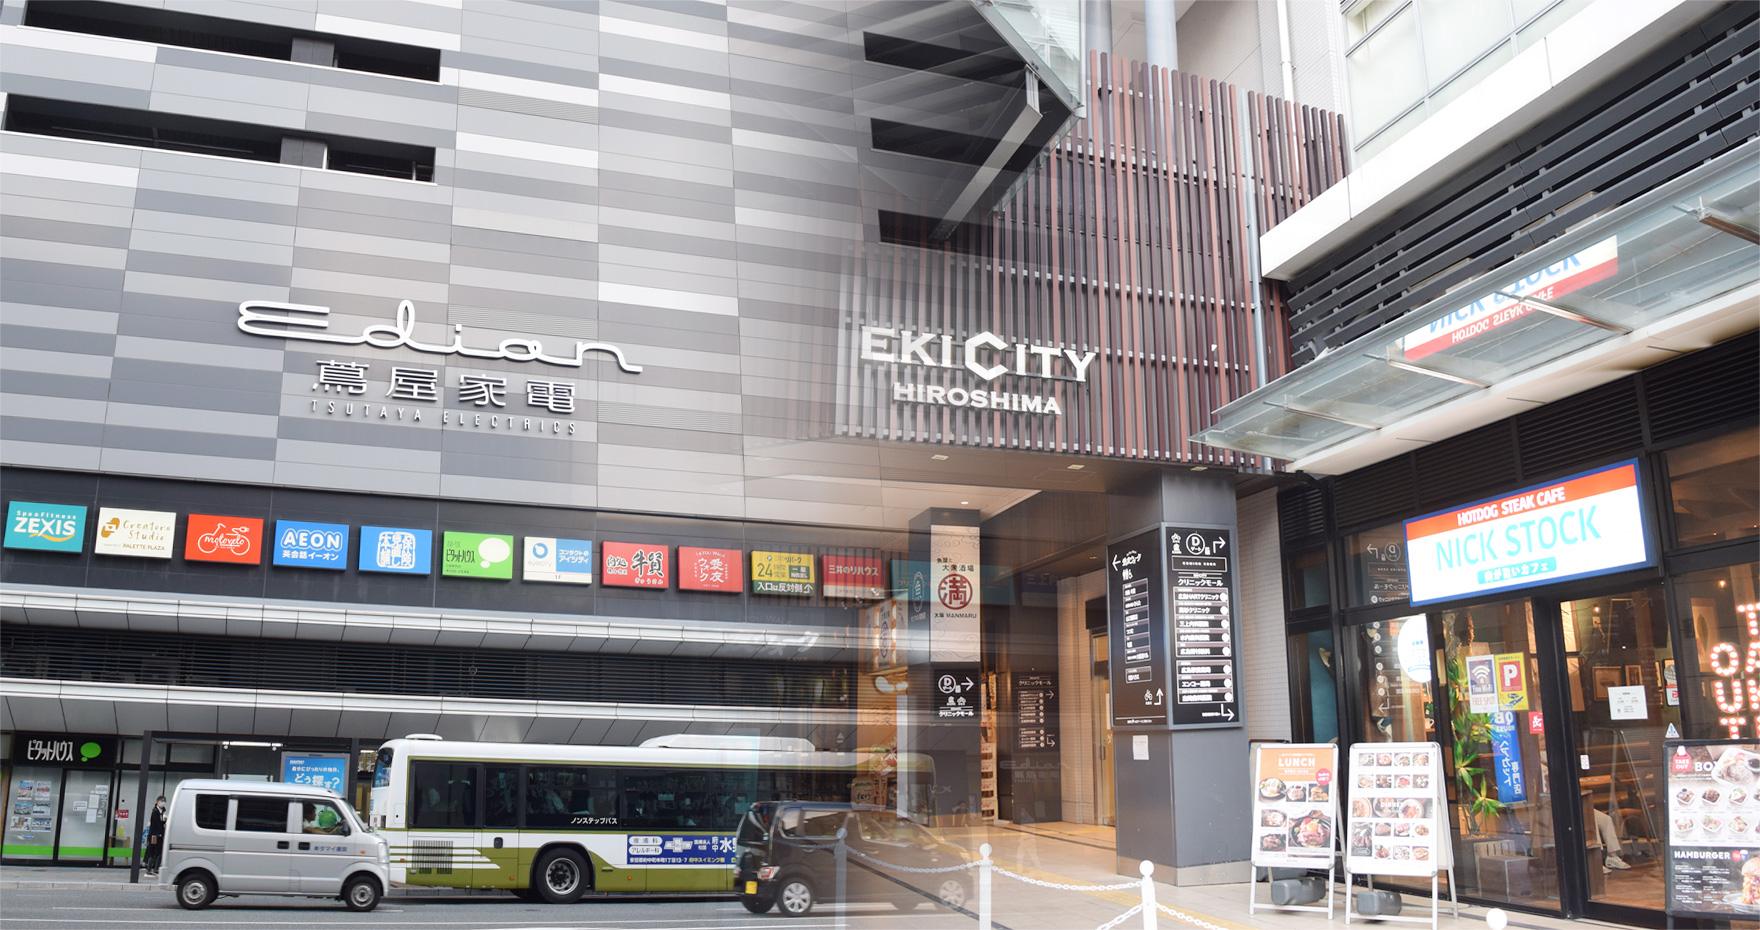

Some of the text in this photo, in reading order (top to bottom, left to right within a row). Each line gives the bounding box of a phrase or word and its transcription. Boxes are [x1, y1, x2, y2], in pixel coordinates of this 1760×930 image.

[312, 359, 577, 414] 蔦屋家電
[893, 382, 1063, 416] HIROSHIMA
[311, 399, 577, 436] TSUTAYA ELECTRICS
[1457, 486, 1567, 527] HOTDOG STEAK CAFE
[13, 517, 77, 537] ZEXIS
[128, 530, 165, 541] Studio
[283, 531, 340, 550] AEON
[1191, 536, 1200, 546] D
[1436, 505, 1602, 571] NICK STOCK
[282, 550, 339, 561] 英会話イーオン
[558, 548, 590, 557] コンタクトの
[558, 555, 589, 565] アイシティ
[757, 563, 773, 578] 24
[829, 564, 880, 577] 三井のリハウス
[942, 564, 974, 572] 大衆酒場
[757, 581, 803, 593] 入口は反対側
[1178, 579, 1223, 587] クリニックモール
[943, 677, 952, 686] D
[1503, 664, 1518, 687] P
[27, 740, 74, 761] ピタットハウス
[1278, 757, 1316, 767] LUNCH
[1694, 761, 1717, 772] BO
[570, 817, 618, 825] ノンステップバス
[711, 836, 719, 853] 府中
[1674, 851, 1731, 860] HAMBURGER
